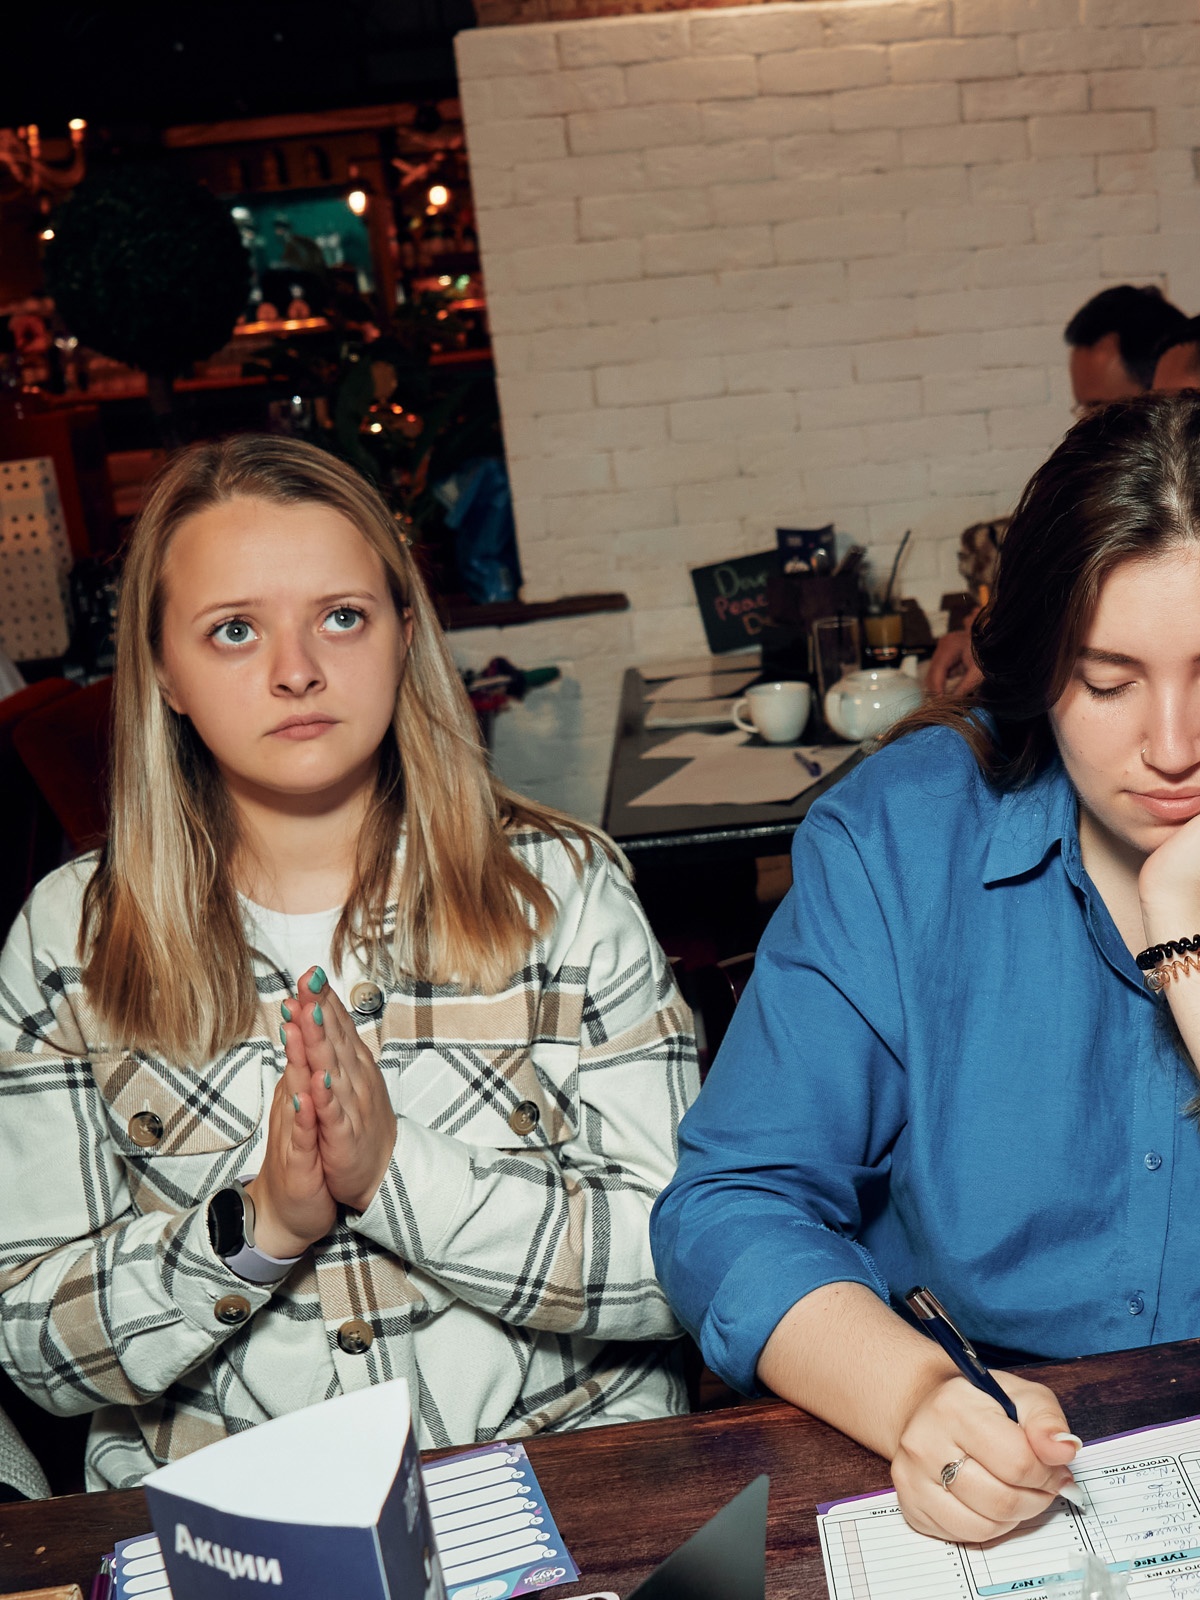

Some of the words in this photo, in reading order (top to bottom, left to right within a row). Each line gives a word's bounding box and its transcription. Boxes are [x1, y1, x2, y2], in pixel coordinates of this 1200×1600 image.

[1138, 1458, 1169, 1467] ИТОГО
[175, 1523, 282, 1585] Акции
[1160, 1552, 1187, 1562] ТУР
[1133, 1557, 1156, 1568] №6
[1011, 1580, 1034, 1589] №7
